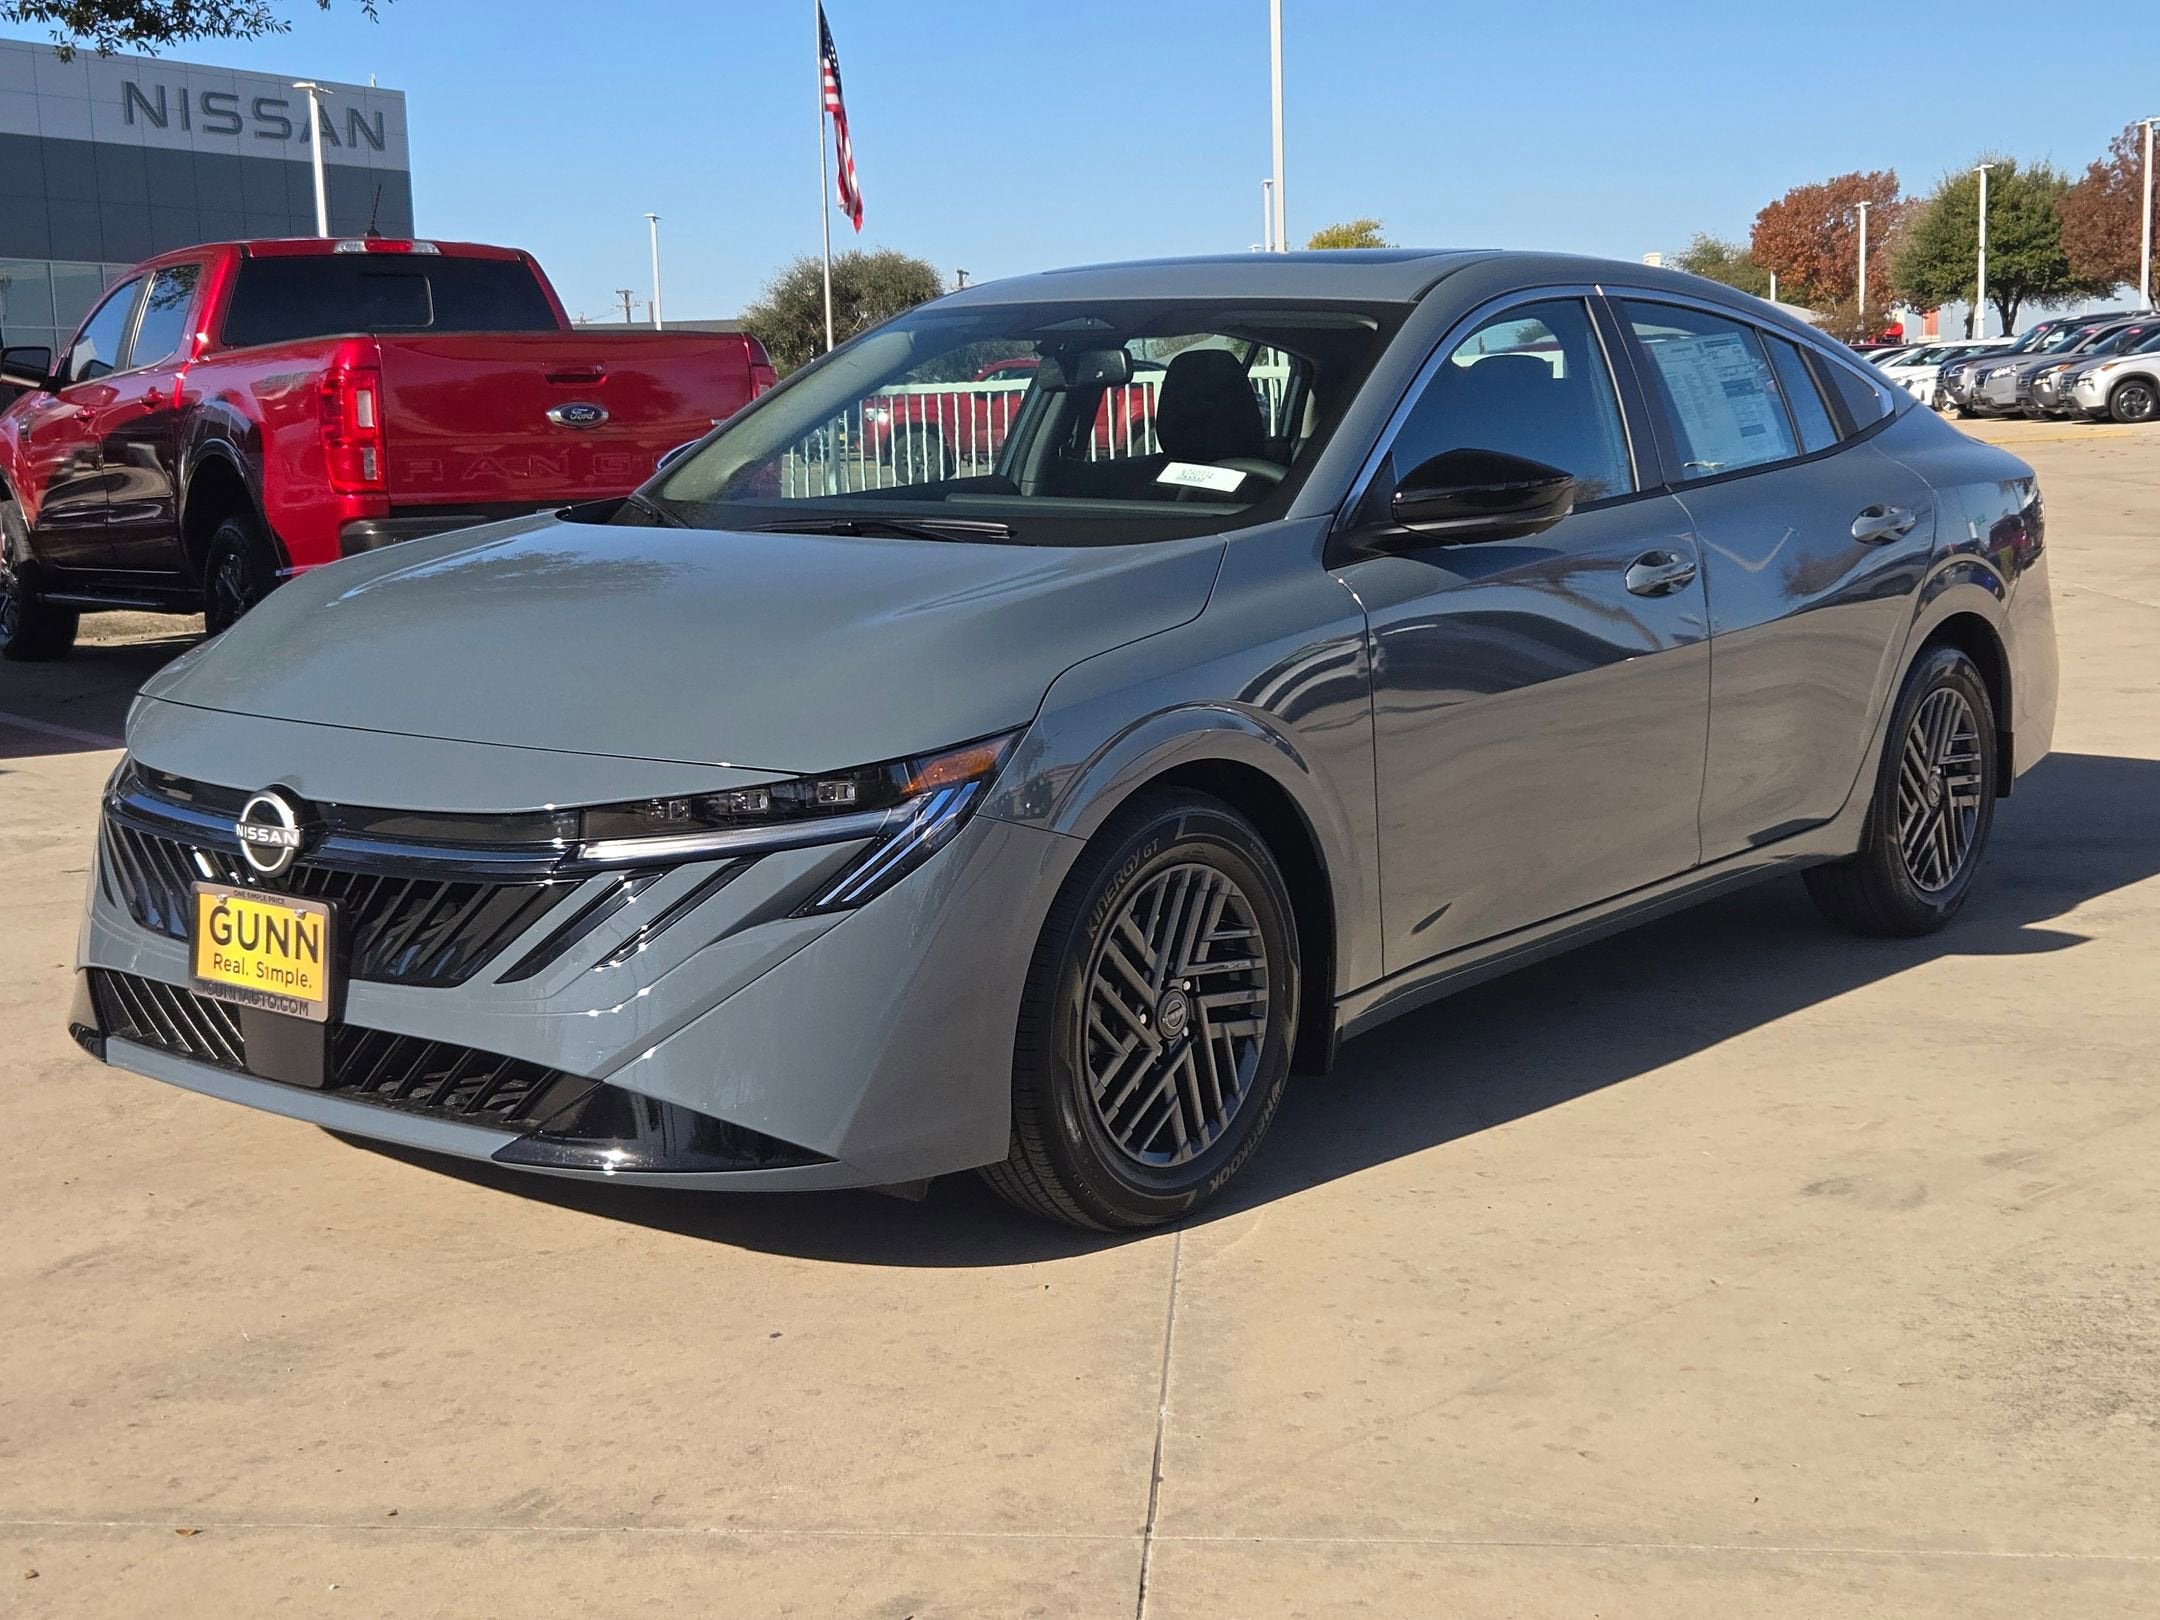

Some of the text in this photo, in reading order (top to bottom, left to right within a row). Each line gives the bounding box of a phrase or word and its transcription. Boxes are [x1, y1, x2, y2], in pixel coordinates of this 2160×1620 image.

[121, 80, 386, 151] NISSAN
[569, 407, 595, 421] Ford
[401, 453, 660, 483] RANG
[235, 822, 299, 848] NISSAN
[1143, 838, 1160, 858] GT
[233, 889, 285, 905] ONE SIMPLE PRICE
[209, 905, 319, 963] GUNN
[213, 953, 249, 976] Real.
[206, 982, 309, 1017] GUNNAUTO.COM
